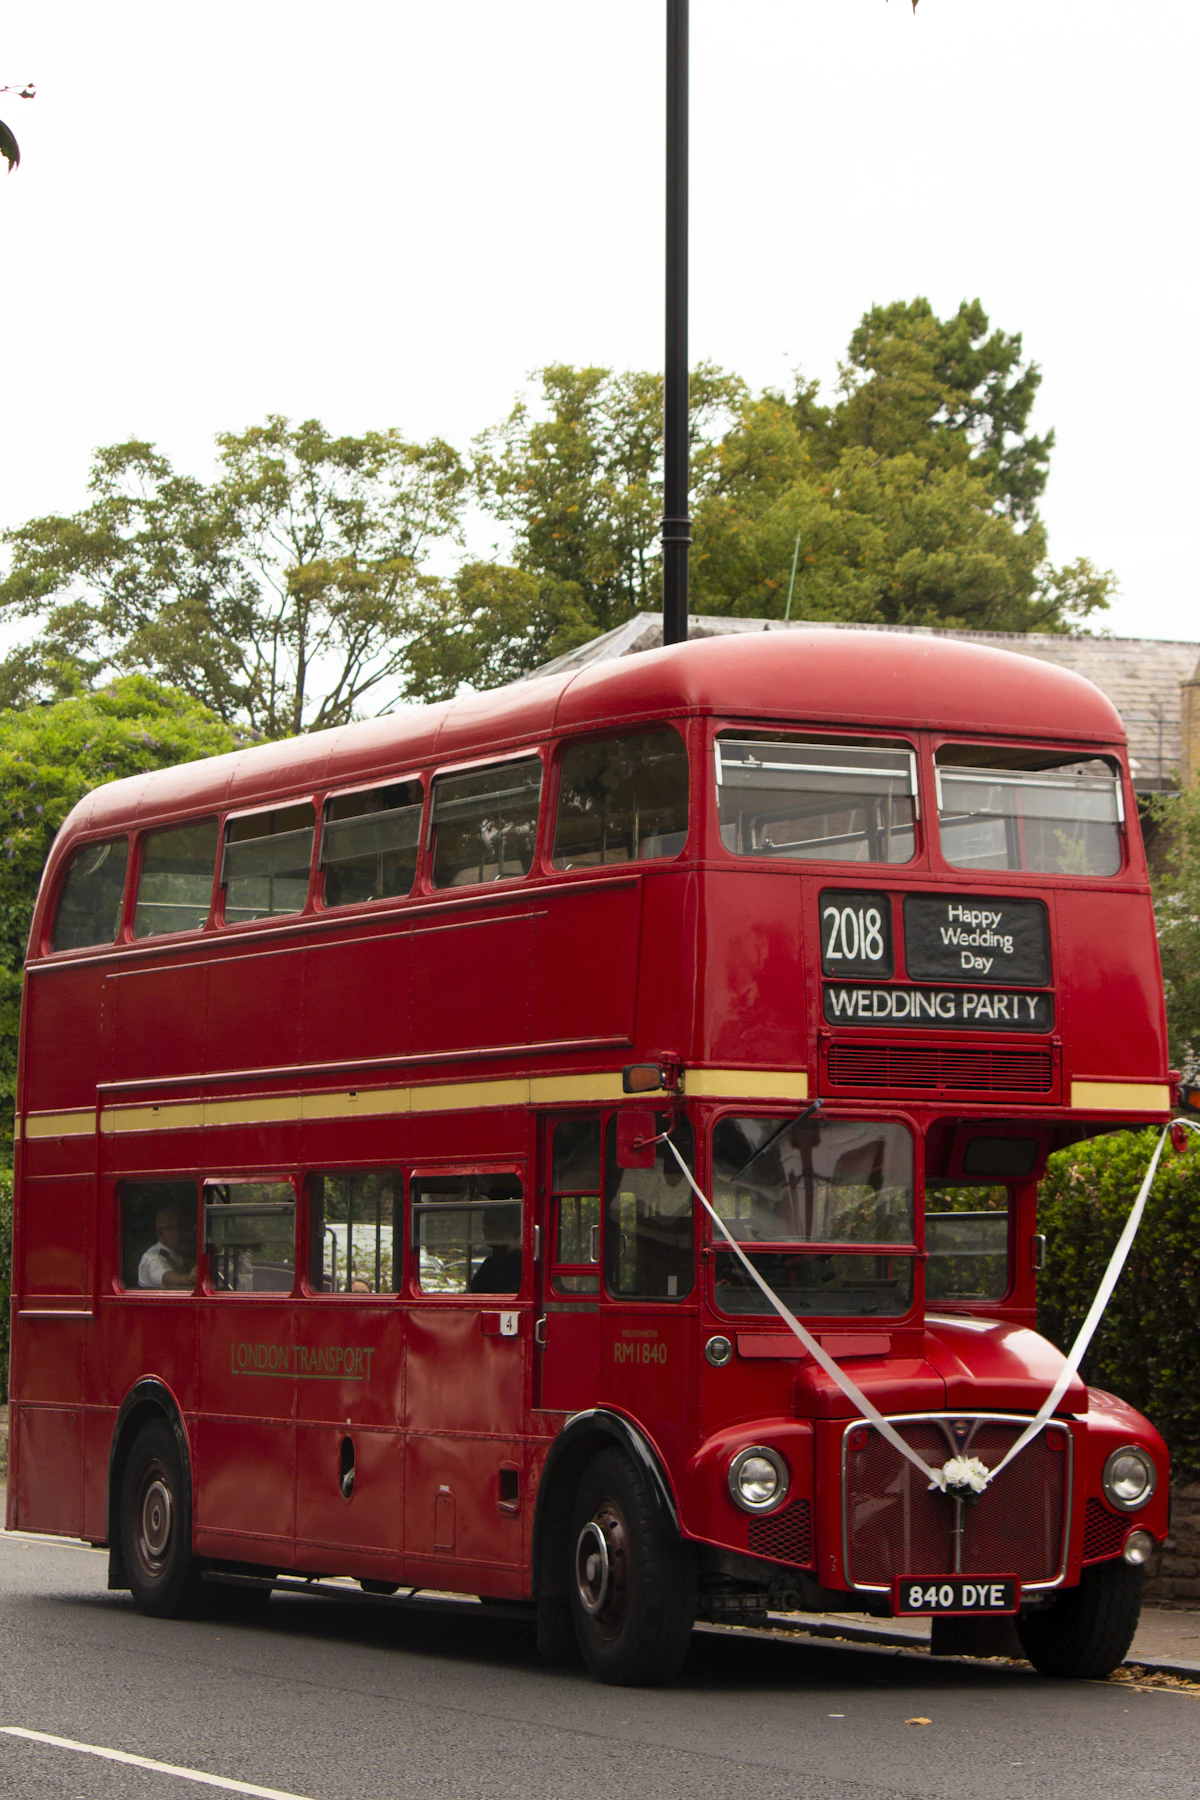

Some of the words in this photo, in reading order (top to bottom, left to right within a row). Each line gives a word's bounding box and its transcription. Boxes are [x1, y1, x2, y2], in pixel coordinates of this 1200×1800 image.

[948, 904, 1002, 928] Happy
[823, 906, 884, 961] 2018
[940, 927, 1014, 954] Wedding
[960, 951, 994, 974] Day
[829, 989, 956, 1018] WEDDING
[962, 993, 1039, 1020] PARTY
[231, 1342, 289, 1375] LONDON
[292, 1345, 376, 1381] TRANSPORT
[614, 1342, 668, 1364] RM1840
[908, 1584, 954, 1608] 840
[962, 1584, 1005, 1607] DYE
